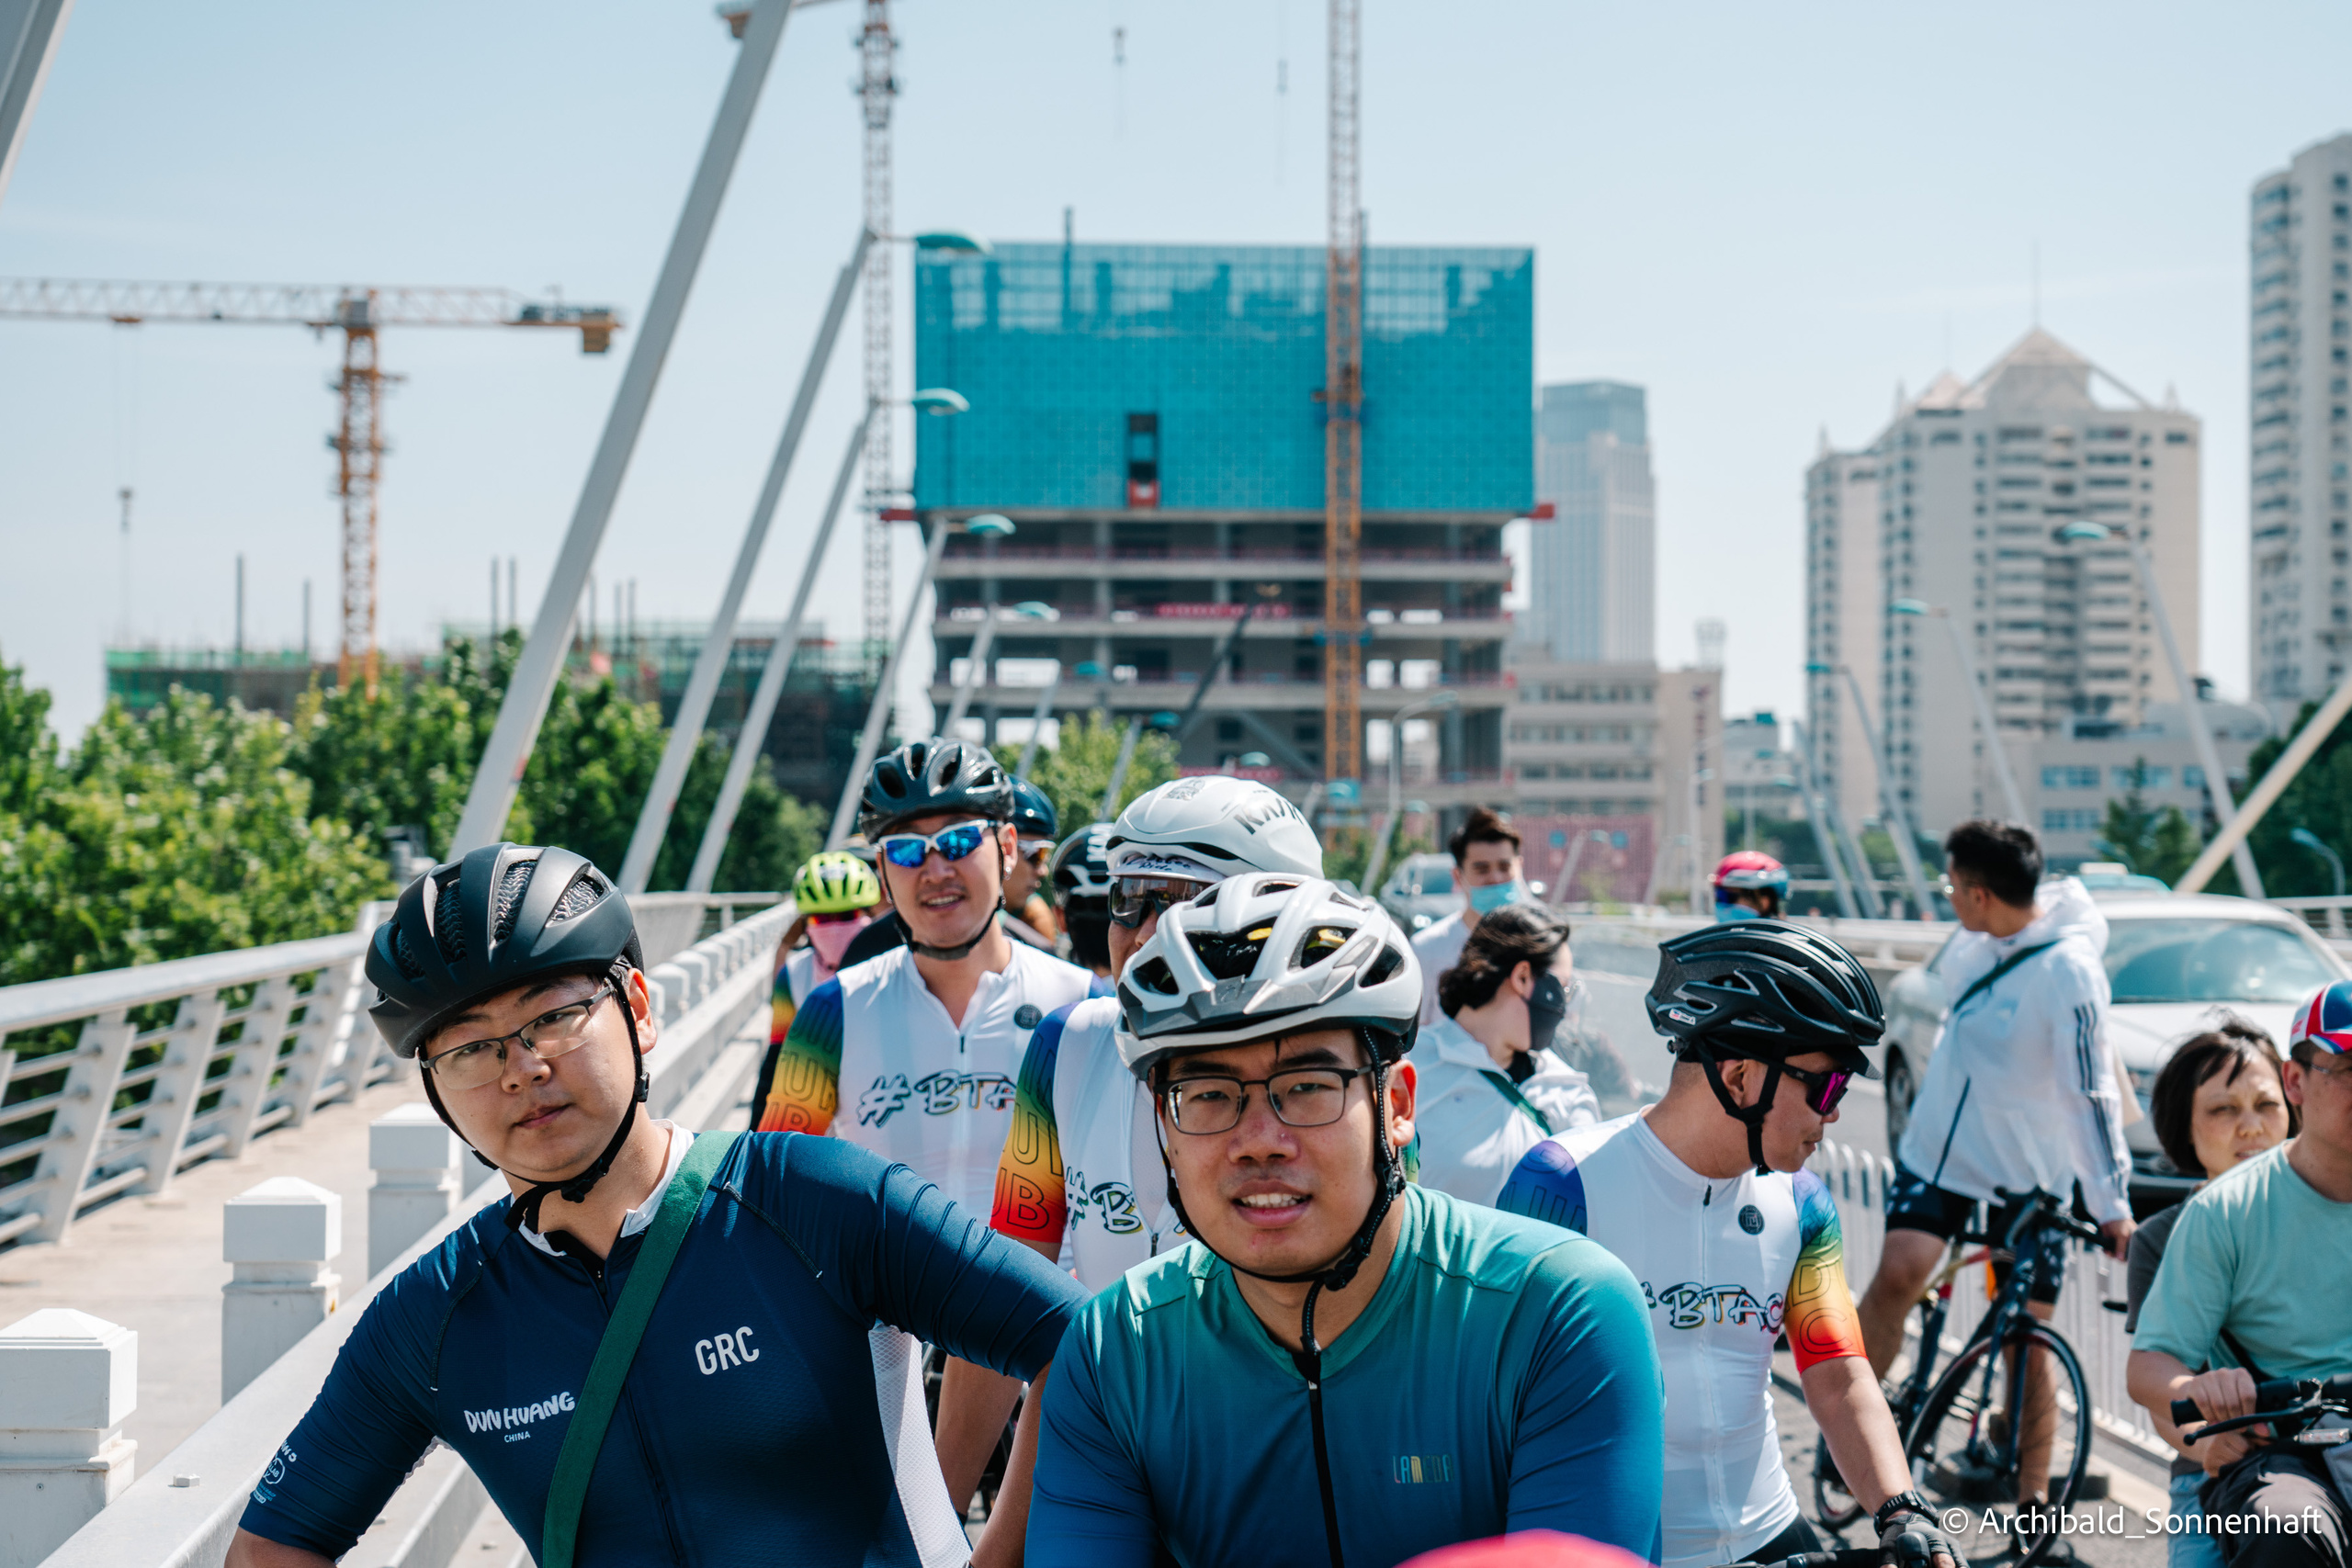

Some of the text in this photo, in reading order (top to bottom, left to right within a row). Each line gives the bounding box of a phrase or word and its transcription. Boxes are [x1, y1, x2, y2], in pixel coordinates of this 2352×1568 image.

[856, 1068, 1017, 1128] #BTA
[695, 1325, 760, 1375] GRC
[503, 1430, 531, 1443] CHINA
